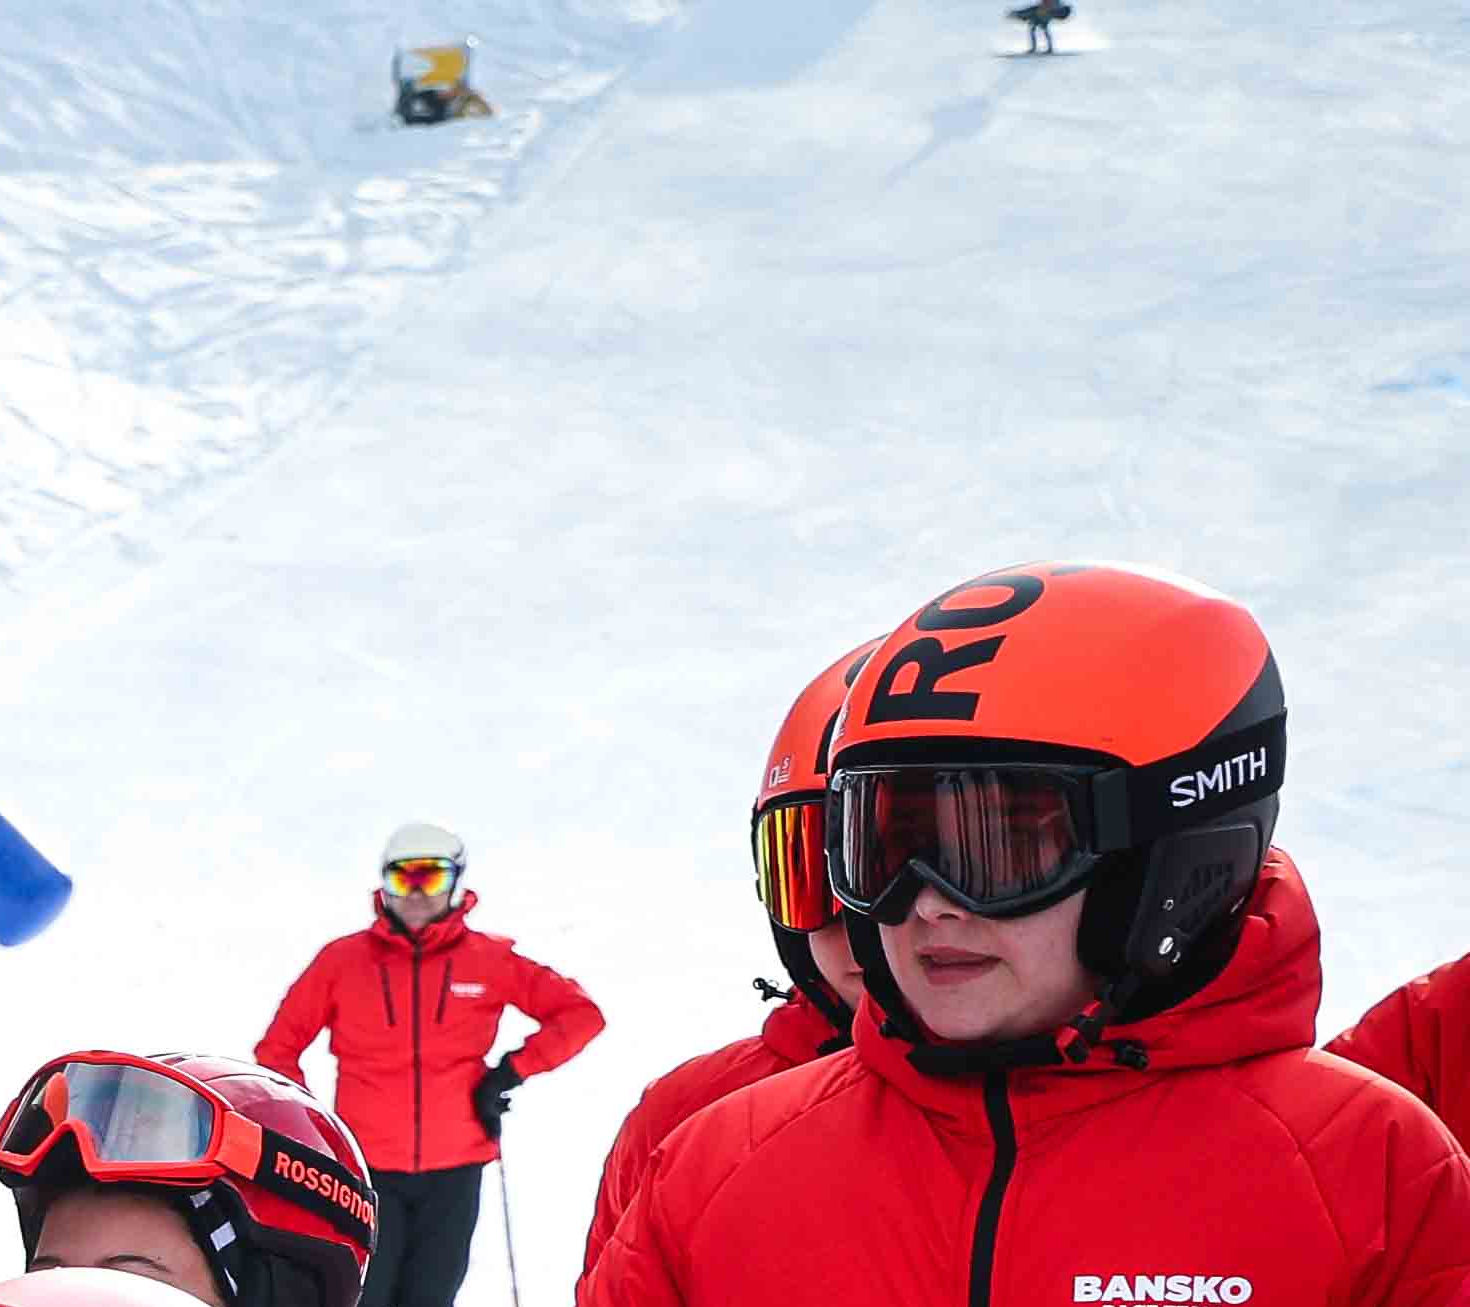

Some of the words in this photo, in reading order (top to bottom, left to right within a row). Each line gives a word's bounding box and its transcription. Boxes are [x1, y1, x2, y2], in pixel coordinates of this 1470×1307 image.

[1170, 747, 1267, 808] SMITH
[275, 1150, 377, 1232] ROSSIGNOL
[1072, 1275, 1253, 1305] BANSKO
